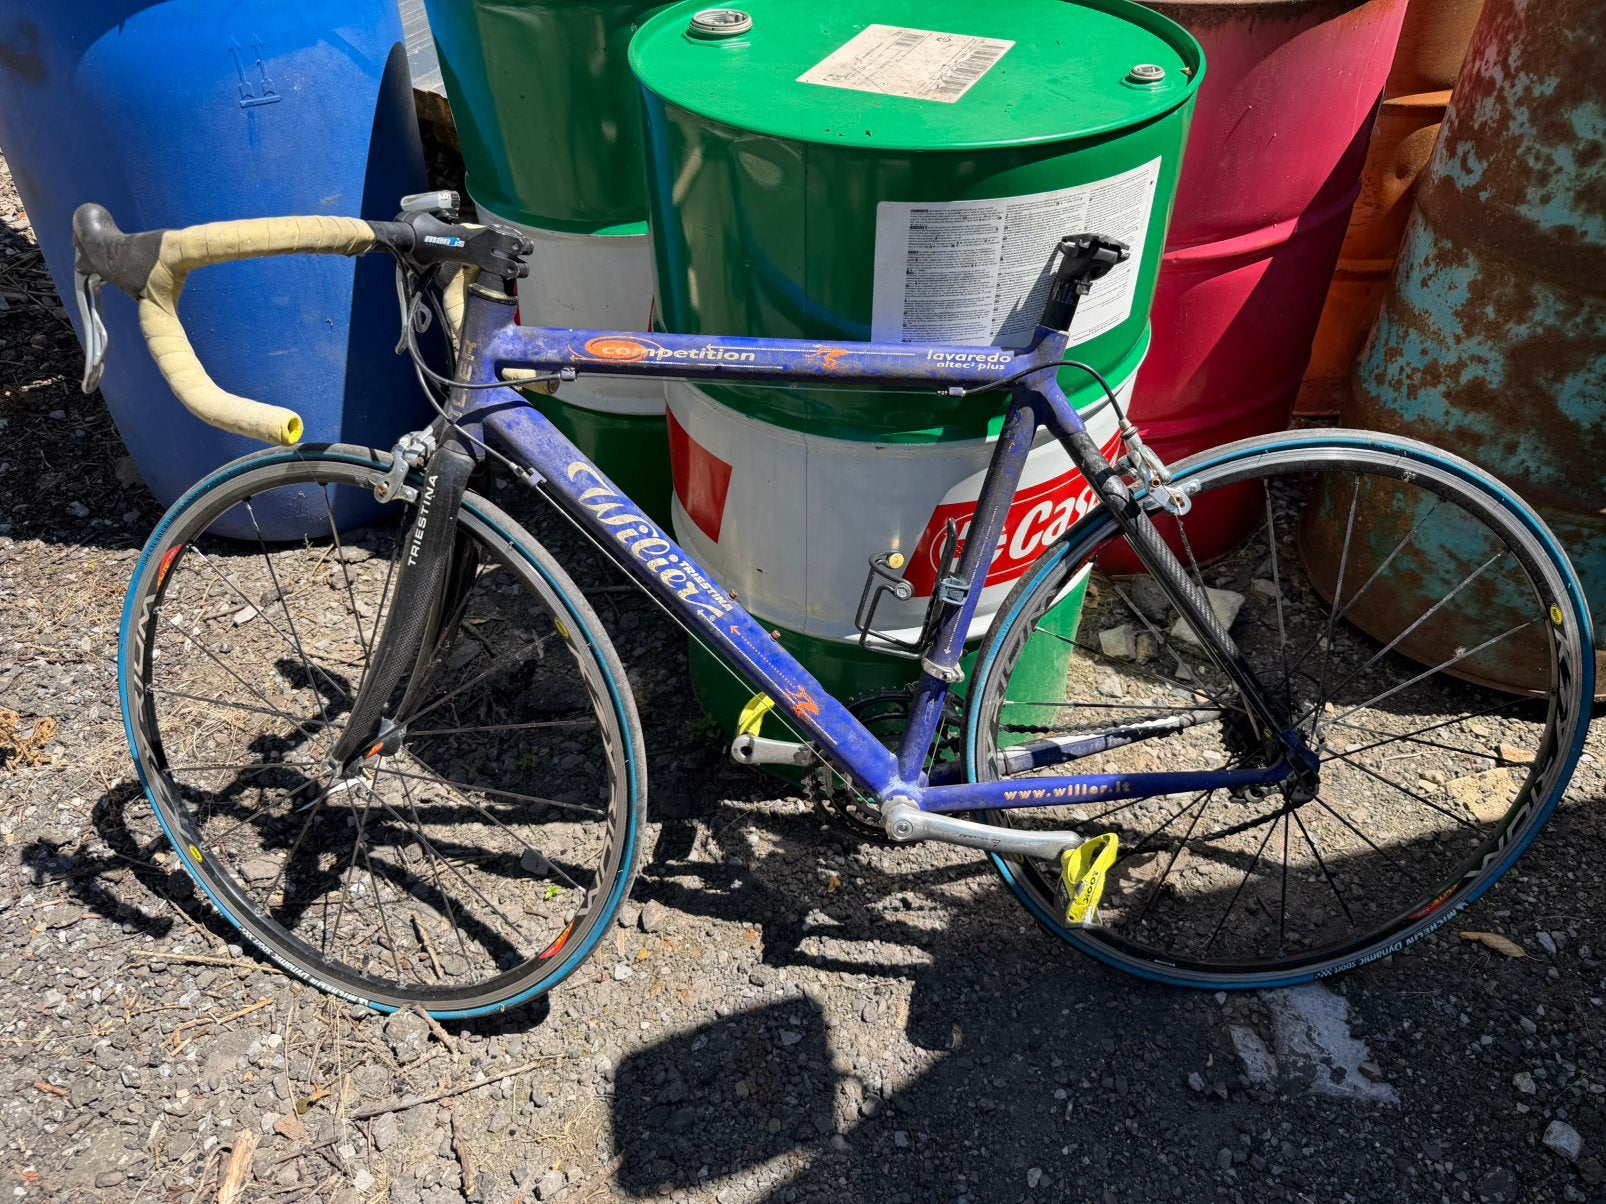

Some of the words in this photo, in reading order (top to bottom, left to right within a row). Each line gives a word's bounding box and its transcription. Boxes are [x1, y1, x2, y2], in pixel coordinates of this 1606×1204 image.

[601, 347, 756, 361] competition
[926, 350, 1012, 363] lavaredo
[977, 362, 1005, 371] plus
[408, 475, 438, 566] TRIESTINA
[678, 560, 735, 612] TRIESTINA
[1405, 908, 1458, 946] MICHELIN
[1359, 942, 1403, 966] Dynamic
